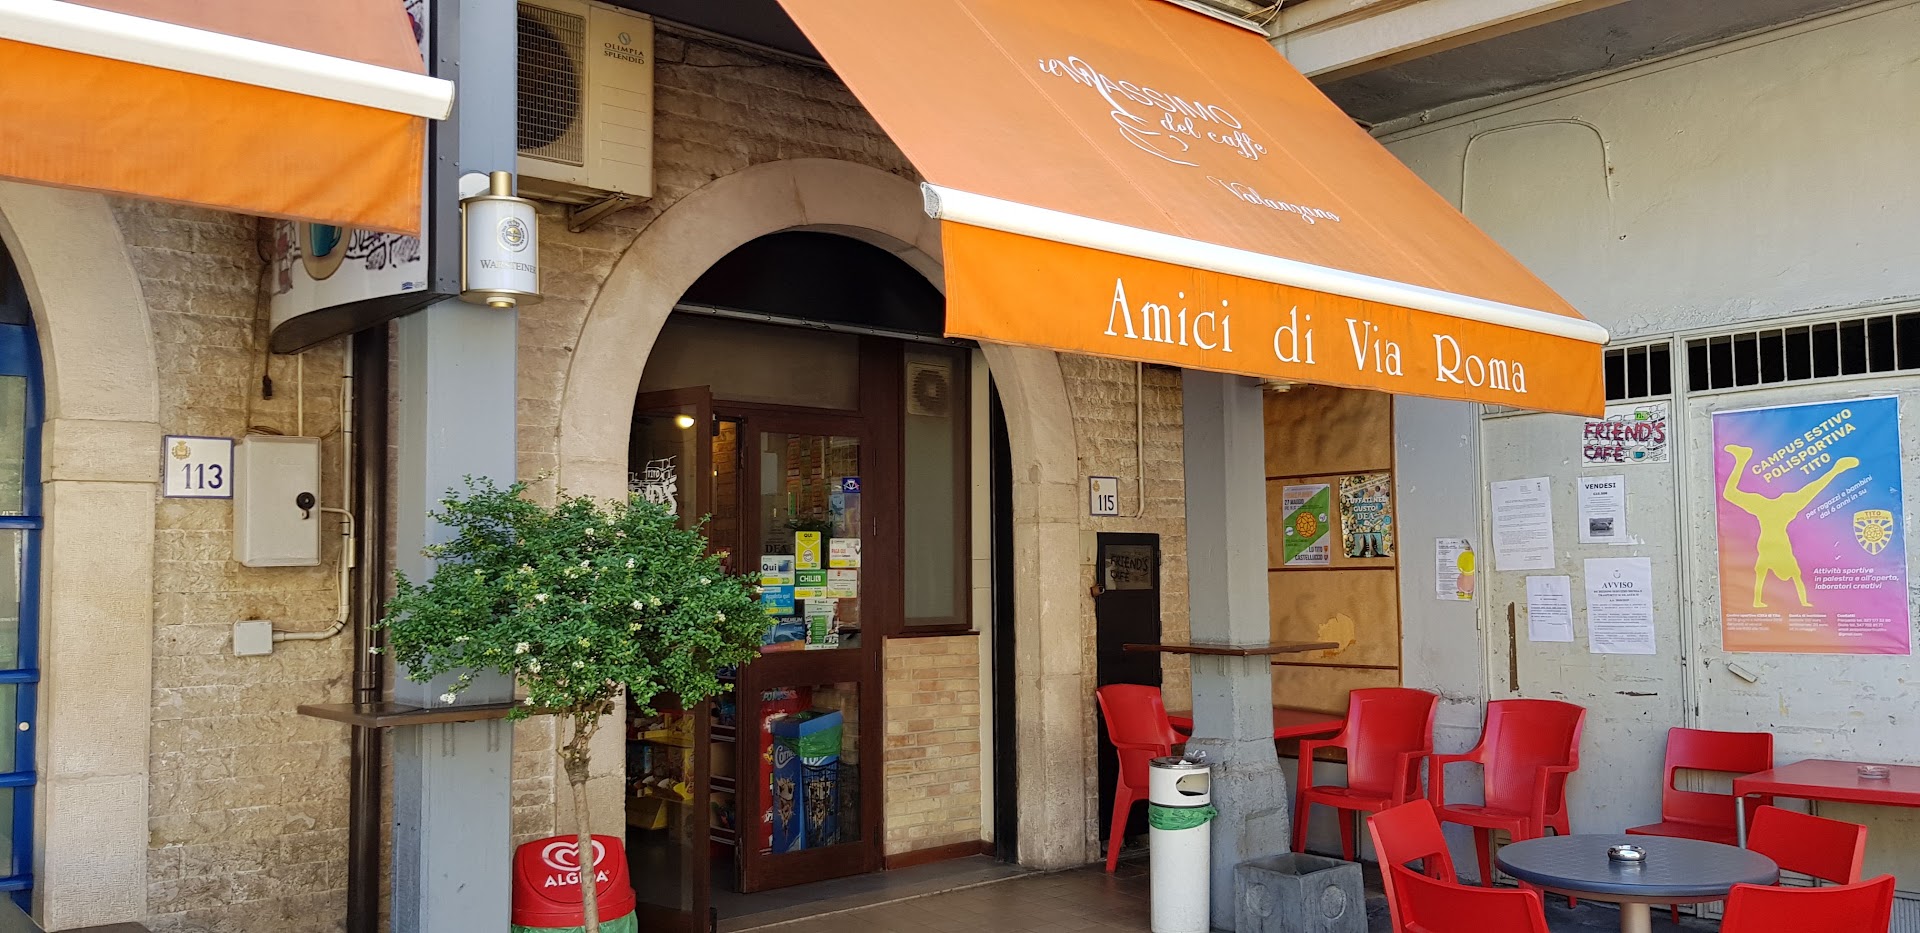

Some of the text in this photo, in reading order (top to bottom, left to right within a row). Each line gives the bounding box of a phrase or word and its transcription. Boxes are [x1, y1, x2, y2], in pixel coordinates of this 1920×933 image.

[603, 50, 645, 65] SPLENDID
[604, 42, 644, 57] OLIMPIA
[1056, 55, 1242, 129] MASSIMO
[1160, 112, 1201, 139] del
[1103, 277, 1528, 393] Amici di Via Roma
[1584, 421, 1666, 444] FRIEND'S
[1751, 408, 1852, 475] CAMPUS ESTIVO
[1763, 422, 1857, 483] POLISPORTIVA
[1800, 453, 1831, 475] TITO
[181, 463, 223, 490] 113
[1584, 482, 1617, 490] VENDESI
[1099, 494, 1115, 512] 115
[1805, 508, 1817, 519] per
[1846, 475, 1873, 494] bambini
[1820, 510, 1831, 519] dai
[1836, 498, 1851, 509] anni
[1858, 488, 1867, 496] su
[1357, 512, 1375, 520] DEA
[762, 563, 777, 572] Qui
[1842, 567, 1874, 575] sportive
[1602, 581, 1634, 589] AVVISO
[544, 870, 609, 888] ALGIA
